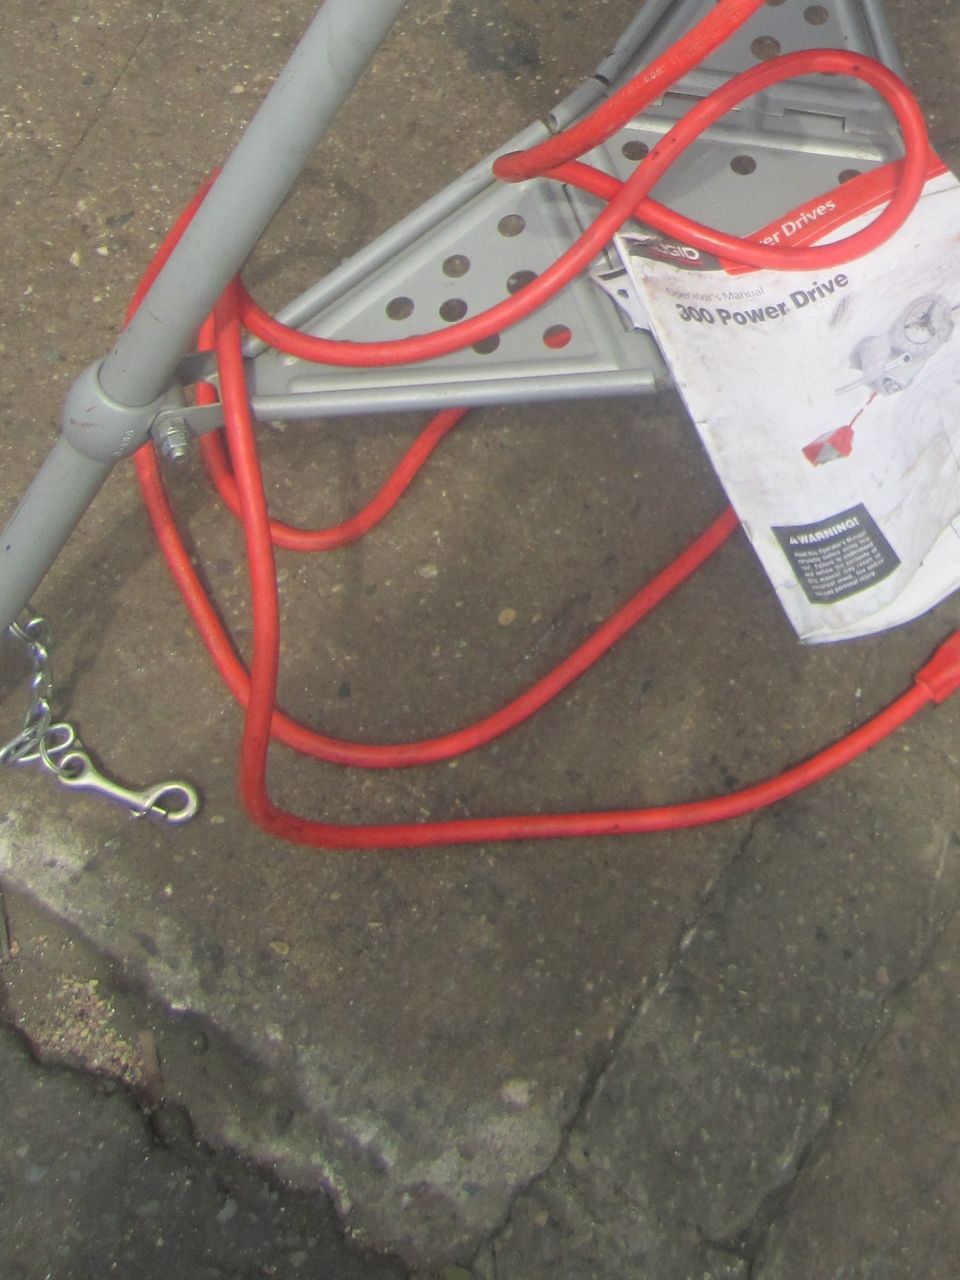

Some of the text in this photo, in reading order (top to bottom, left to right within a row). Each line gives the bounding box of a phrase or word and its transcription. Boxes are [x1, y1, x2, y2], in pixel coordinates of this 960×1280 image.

[781, 200, 837, 238] Drives
[666, 285, 765, 302] Operator's Manual
[675, 272, 849, 326] 300 Power Drive
[800, 517, 860, 545] WARNING!
